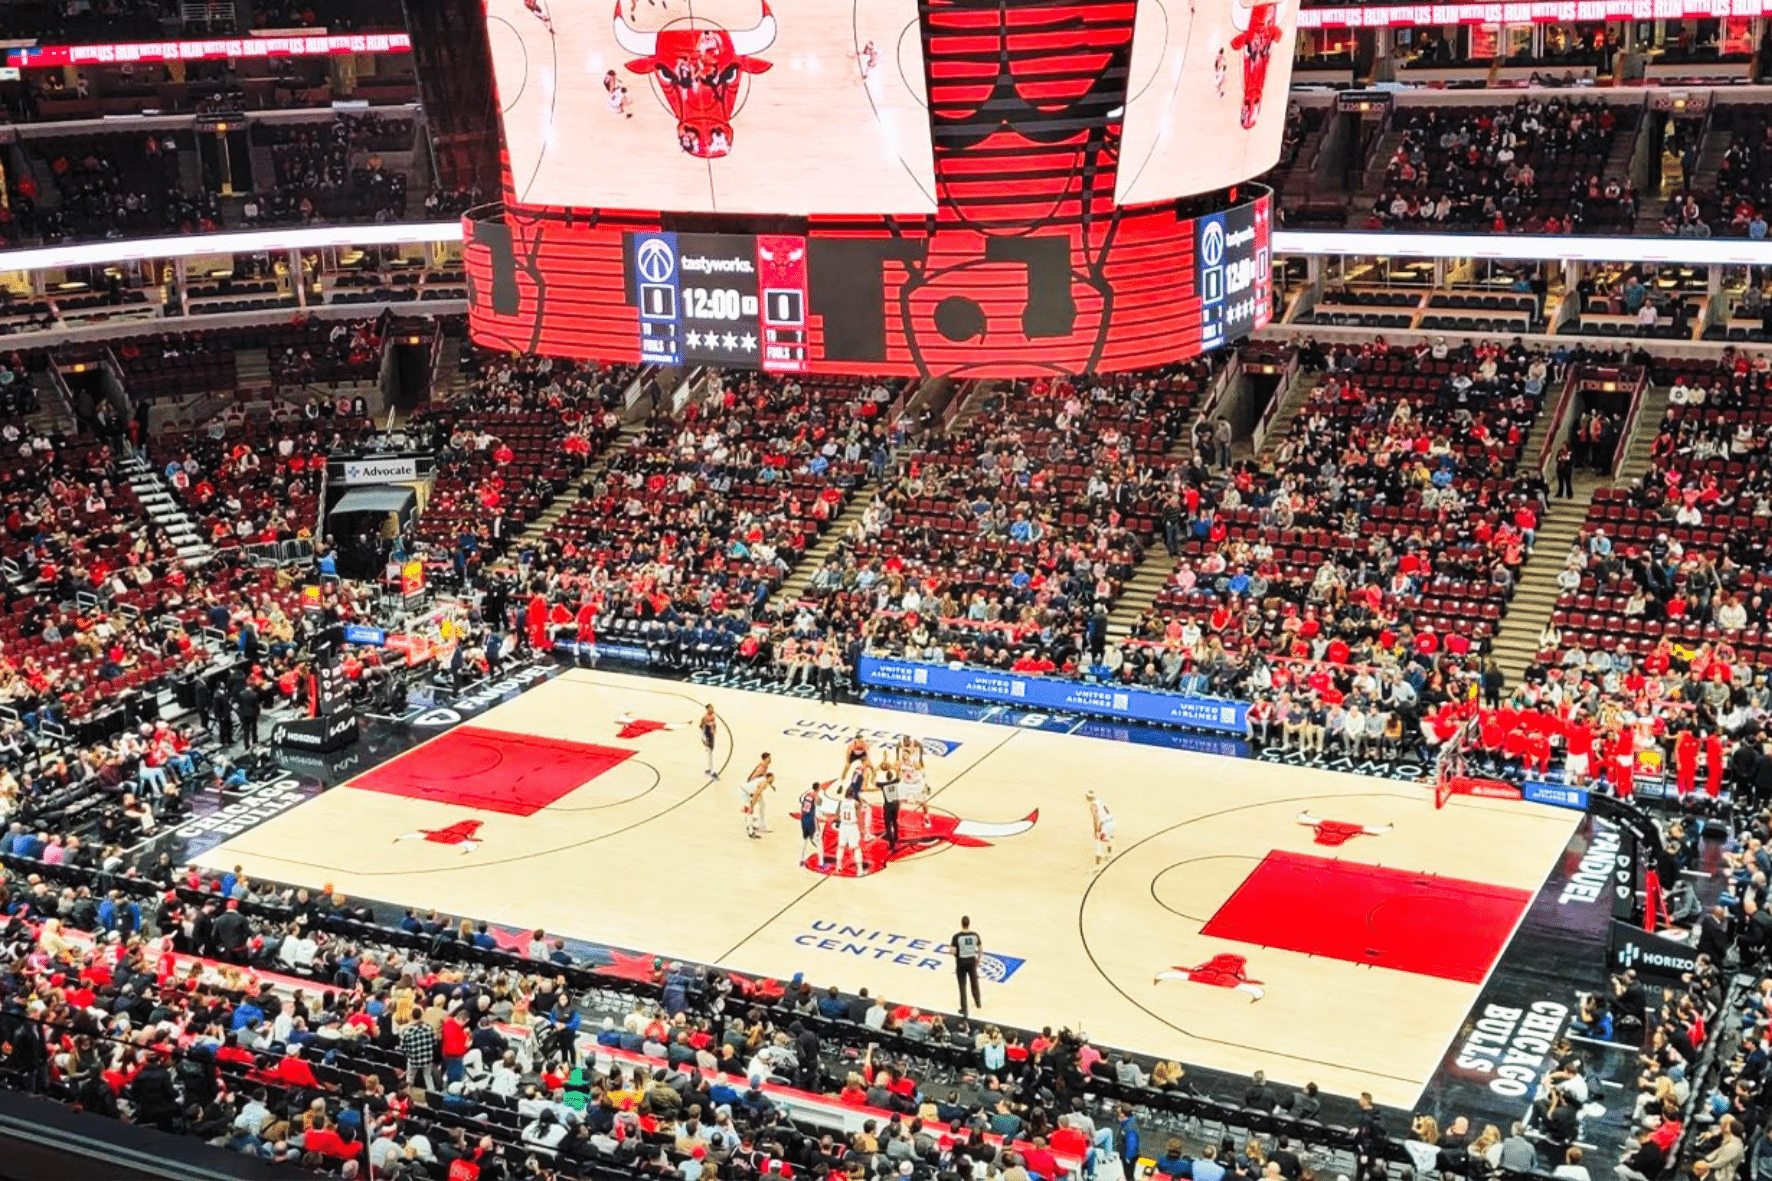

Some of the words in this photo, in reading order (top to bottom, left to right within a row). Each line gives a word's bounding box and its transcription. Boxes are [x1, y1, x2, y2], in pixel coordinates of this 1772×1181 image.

[681, 255, 754, 274] tastyworks.
[683, 288, 740, 320] 12:00
[363, 466, 411, 476] Advocate
[871, 671, 912, 682] AIRLINES
[880, 666, 913, 675] UNITED
[975, 677, 1010, 687] UNITED
[966, 683, 1009, 694] AIRLINES
[1066, 695, 1111, 707] AIRLINES
[1075, 690, 1111, 700] UNITED
[1180, 703, 1218, 714] UNITED
[1171, 709, 1218, 721] AIRLINES
[288, 732, 321, 744] HORIZON
[175, 780, 300, 837] CHICAGO
[212, 793, 306, 835] BULLS
[1557, 832, 1621, 904] FANDUEL
[795, 935, 942, 970] CENTER
[1643, 953, 1694, 970] HORIZO
[1456, 1003, 1523, 1072] BULLS
[1490, 1001, 1568, 1096] CHICAGO
